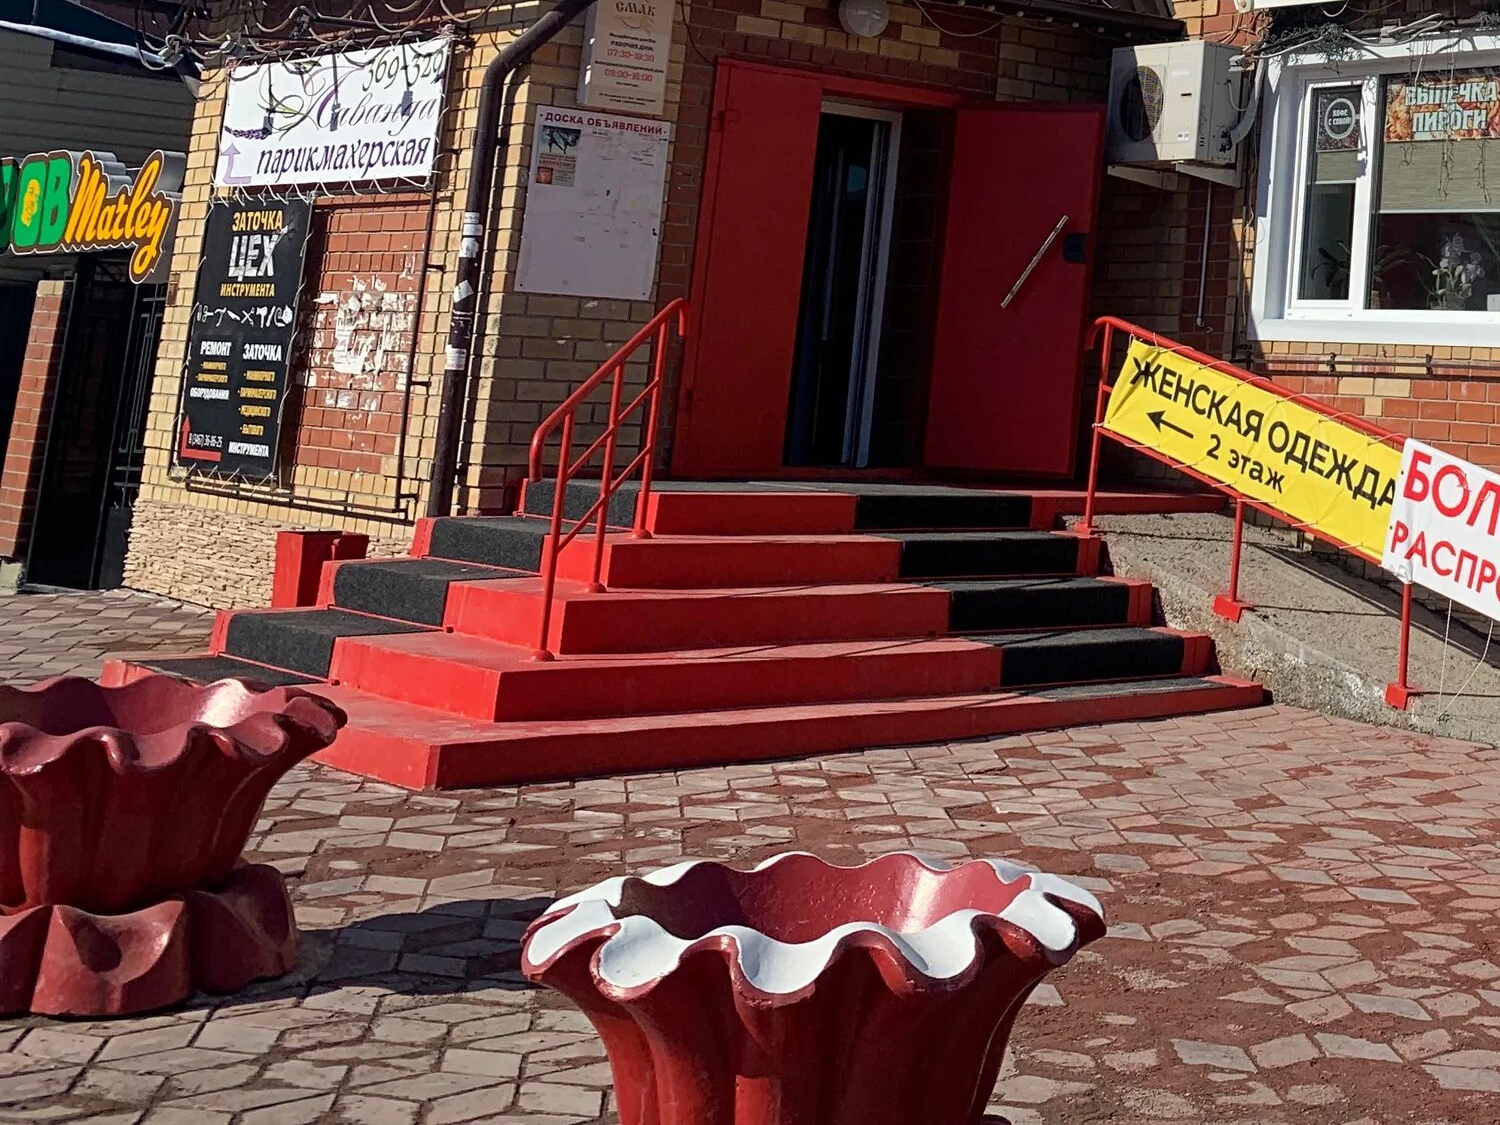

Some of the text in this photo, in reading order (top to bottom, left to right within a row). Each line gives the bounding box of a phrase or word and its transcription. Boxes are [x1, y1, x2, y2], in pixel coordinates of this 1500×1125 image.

[362, 49, 444, 91] 369-329
[1405, 81, 1498, 106] ВЫПЕЧКА
[545, 112, 583, 125] ДОСКА
[587, 117, 663, 136] ОБЪЯВЛЕНИЙ
[1412, 109, 1487, 133] ПИРОГИ
[256, 137, 431, 183] парикмахерская
[64, 158, 169, 275] Marley
[232, 210, 285, 232] ЗАТОЧКА
[228, 234, 281, 282] ЦЕХ
[220, 283, 275, 297] ИНСТРУМЕНТА
[200, 341, 232, 355] РЕМОНТ
[243, 343, 282, 361] ЗАТОЧКА
[1129, 356, 1396, 509] ЖЕНСКАЯ ОДЕЖДА
[1206, 434, 1287, 495] 2 этаж
